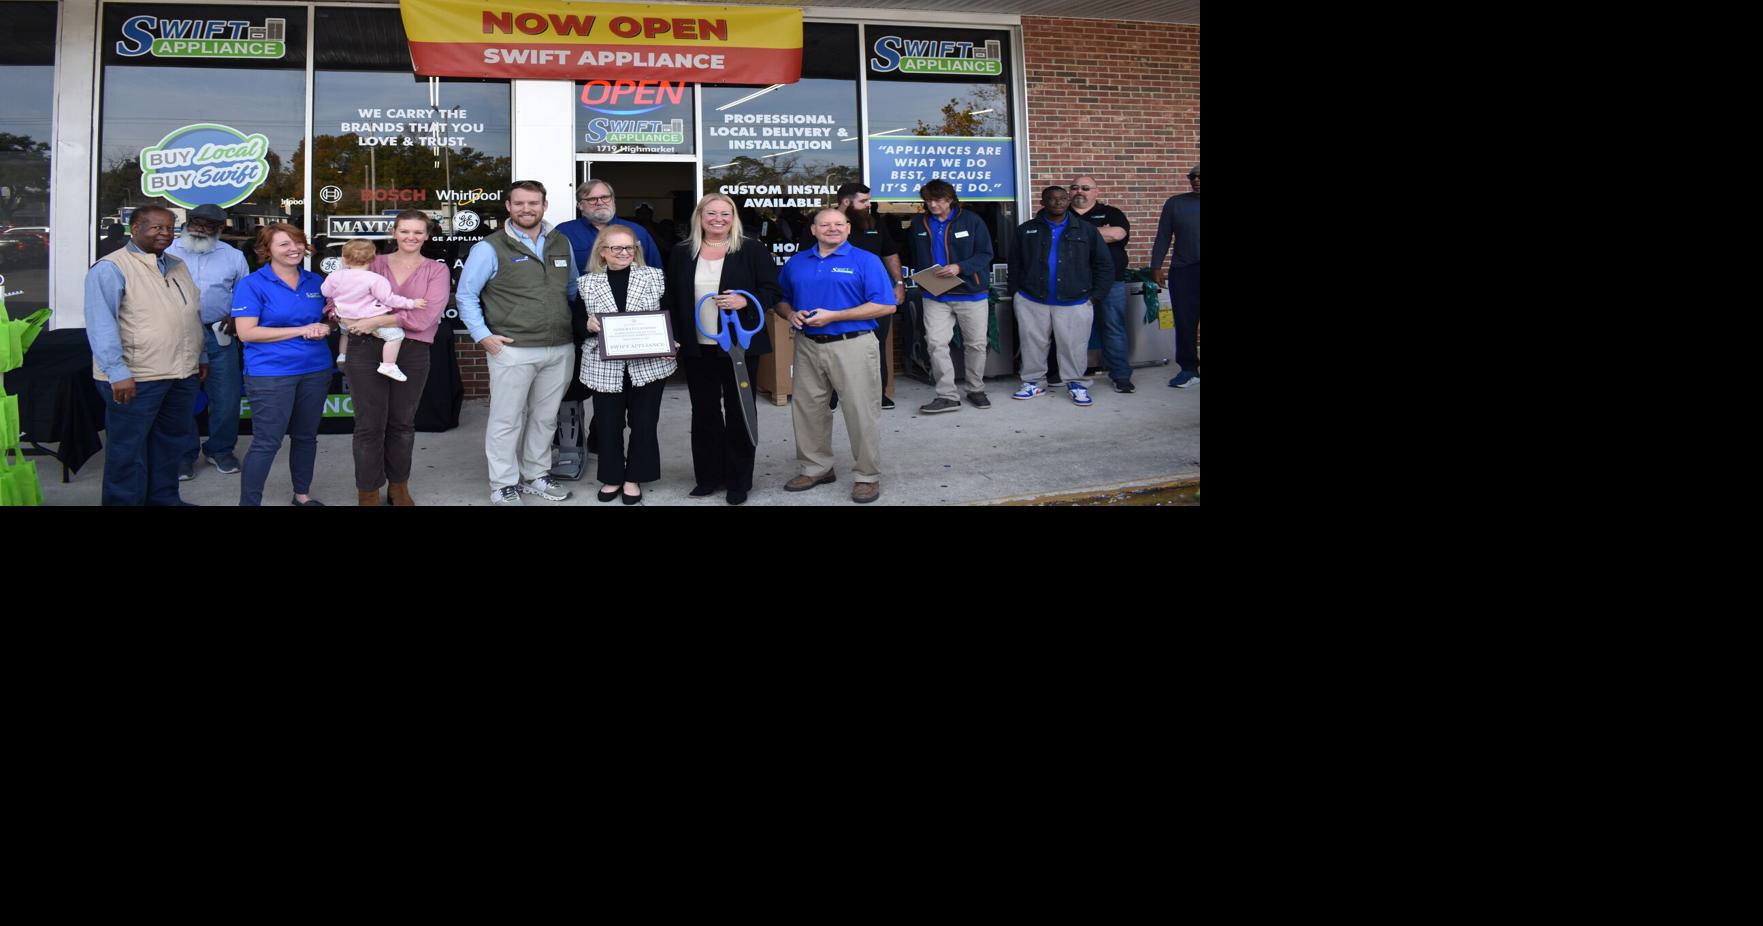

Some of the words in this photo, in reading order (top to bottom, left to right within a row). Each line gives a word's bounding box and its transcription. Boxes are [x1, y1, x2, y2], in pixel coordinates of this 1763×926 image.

[482, 10, 596, 36] NOW
[608, 16, 728, 40] OPEN
[116, 15, 250, 56] SWIFT
[158, 41, 277, 54] APPLIANCE
[483, 48, 570, 65] SWIFT
[577, 51, 725, 69] APPLIANCE
[871, 36, 973, 72] SWIFT
[905, 60, 995, 72] APPLIANCE
[581, 80, 685, 105] OPEN
[358, 108, 381, 119] WE
[386, 108, 434, 119] CARRY
[439, 109, 467, 119] THE
[724, 114, 835, 124] PROFESSIONAL
[341, 122, 404, 132] BRANDS
[409, 122, 447, 132] THAT
[452, 123, 484, 133] YOU
[585, 118, 662, 143] SWIFT
[710, 127, 757, 137] LOCAL
[762, 127, 832, 137] DELIVERY
[836, 127, 848, 137] &
[358, 136, 397, 146] LOVE
[402, 136, 413, 146] &
[419, 136, 467, 146] TRUST.
[610, 134, 679, 142] APPLIANCE
[620, 145, 675, 154] Highmarket
[728, 140, 832, 150] INSTALLATION
[976, 146, 1002, 155] ARE
[150, 151, 190, 166] BUY
[197, 141, 258, 162] Local
[894, 158, 936, 167] WHAT
[941, 159, 961, 168] WE
[966, 159, 987, 168] DO
[151, 173, 192, 189] BUY
[198, 164, 259, 184] Swift
[890, 171, 926, 181] BEST,
[932, 171, 991, 180] BECAUSE
[720, 185, 782, 195] CUSTOM
[787, 185, 841, 195] INSTAL
[880, 183, 907, 192] IT'S
[360, 189, 427, 201] BOSCH
[436, 189, 501, 204] Whirlpool
[744, 198, 822, 208] AVAILABLE
[332, 220, 395, 233] MAYTA
